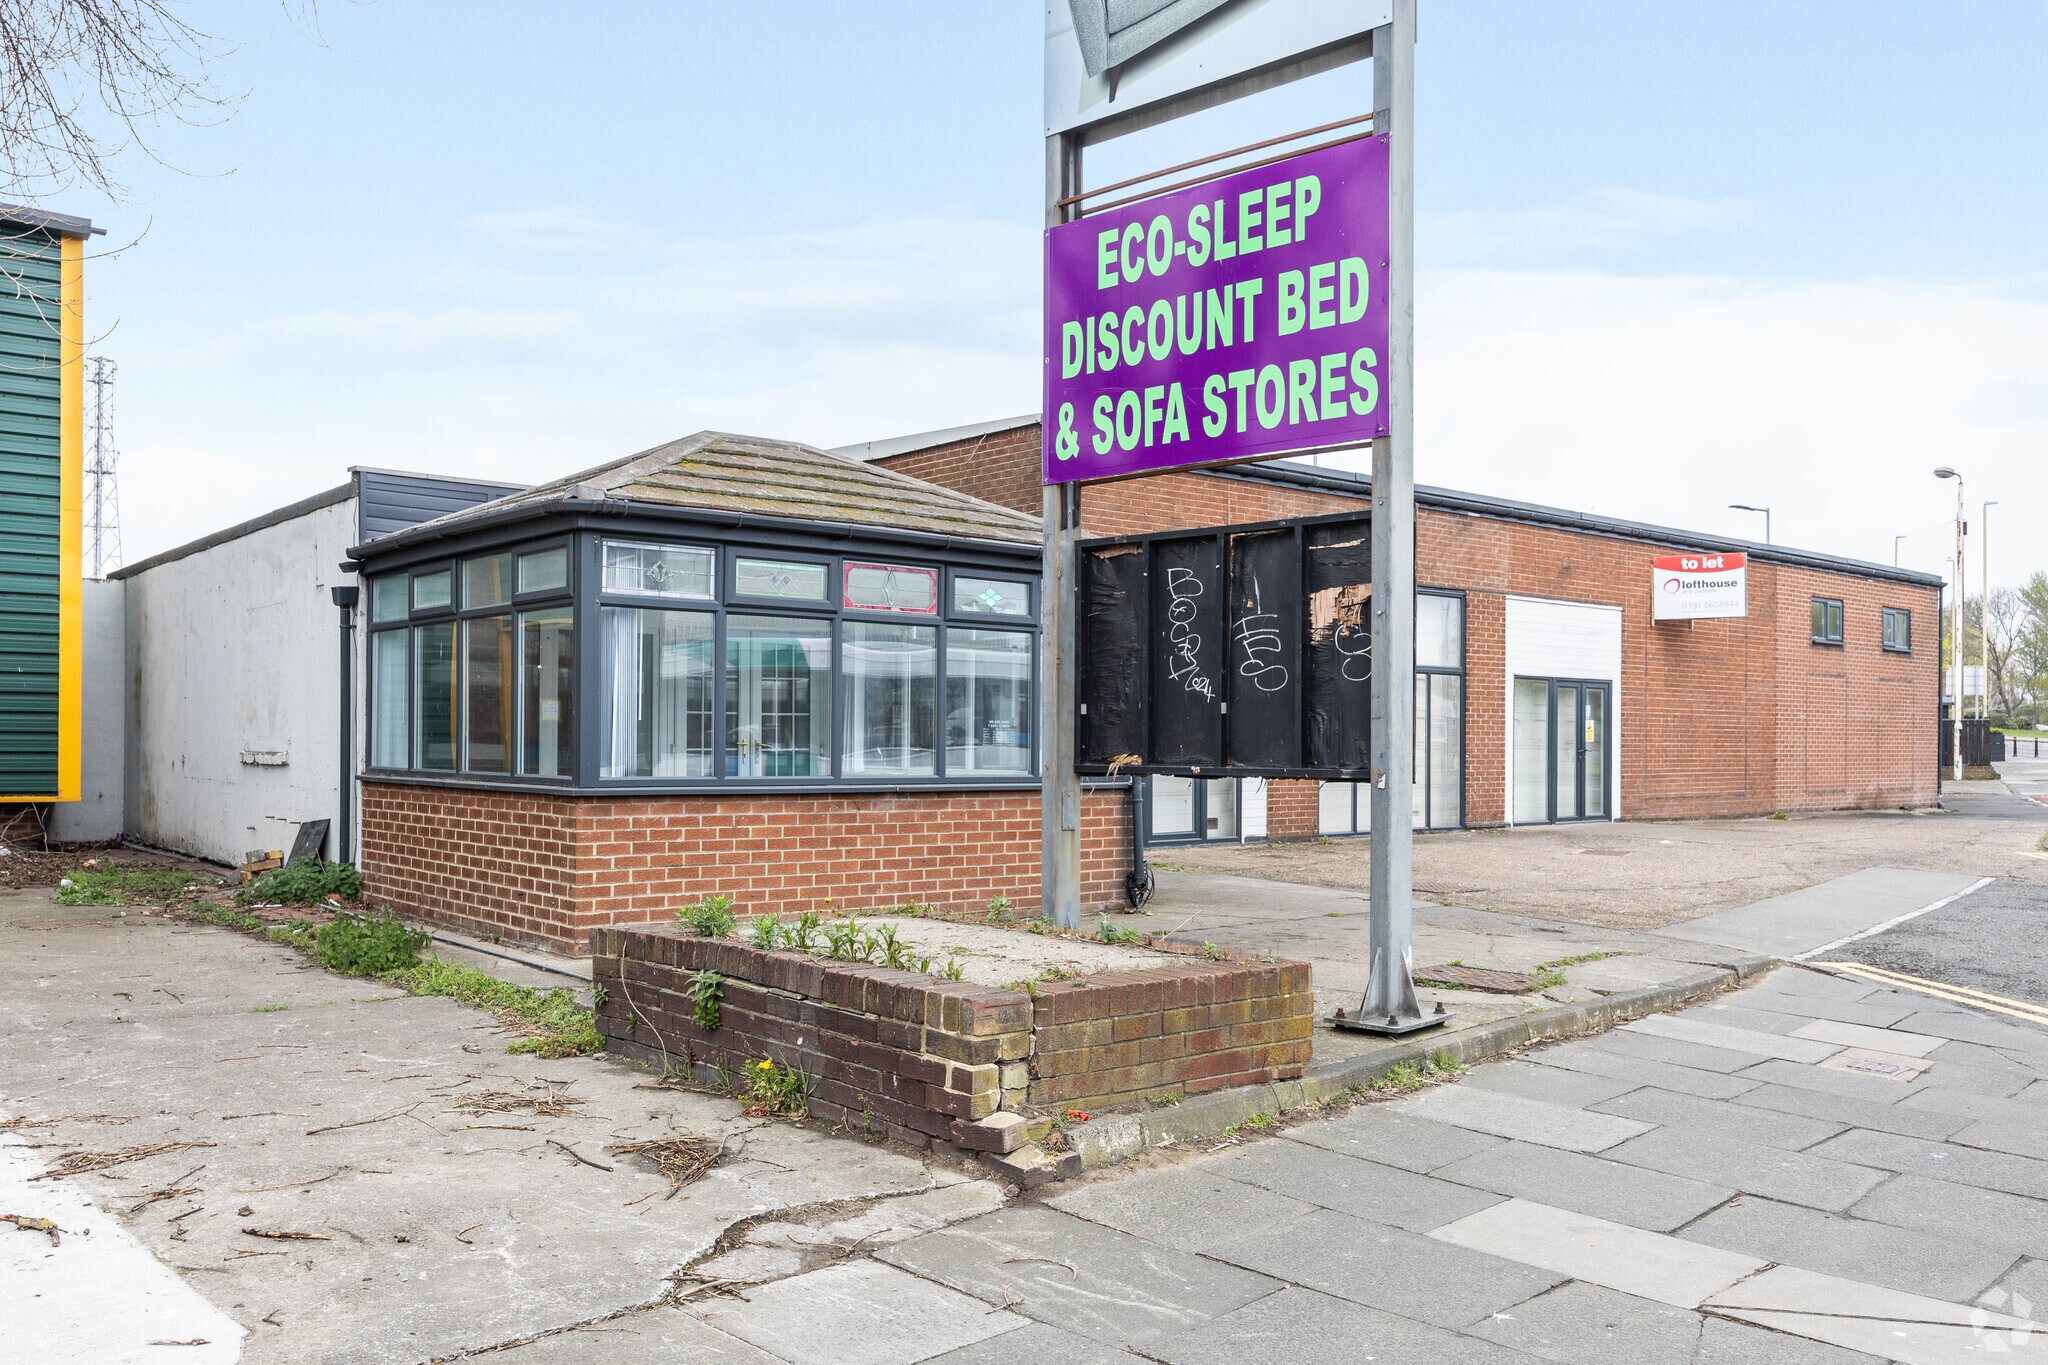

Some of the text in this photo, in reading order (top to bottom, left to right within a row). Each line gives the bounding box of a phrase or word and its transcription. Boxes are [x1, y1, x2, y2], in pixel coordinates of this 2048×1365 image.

[1098, 175, 1321, 290] ECO-SLEEP
[1062, 257, 1369, 380] DISCOUNT BED
[1055, 347, 1379, 460] & SOFA STORES
[1681, 556, 1724, 570] to let
[1682, 580, 1738, 589] lofthouse
[1682, 601, 1701, 609] 0191
